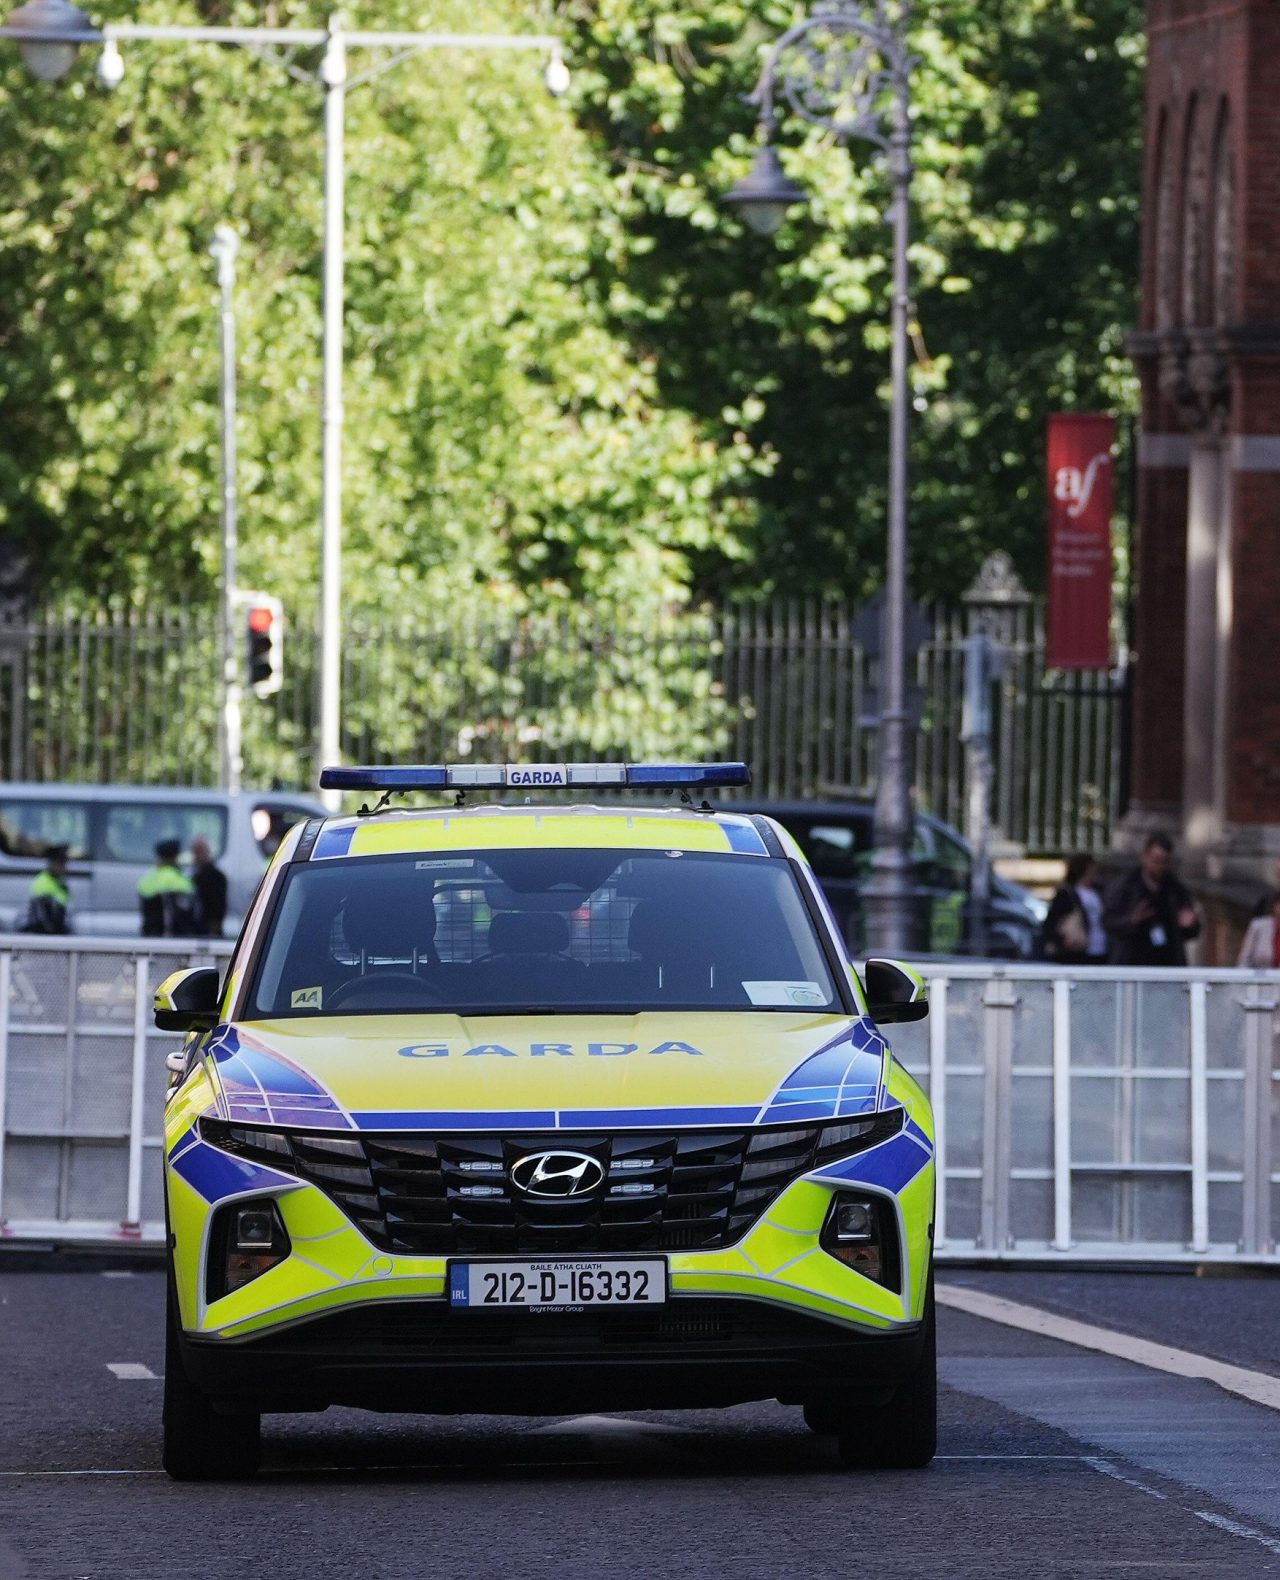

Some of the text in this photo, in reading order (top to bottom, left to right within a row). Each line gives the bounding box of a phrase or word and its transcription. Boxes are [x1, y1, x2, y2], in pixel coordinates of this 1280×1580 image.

[511, 771, 562, 785] GARDA
[294, 991, 318, 1004] AA
[398, 1041, 704, 1057] GARDA
[483, 1271, 649, 1303] 212-D-16332
[452, 1290, 467, 1300] IRL
